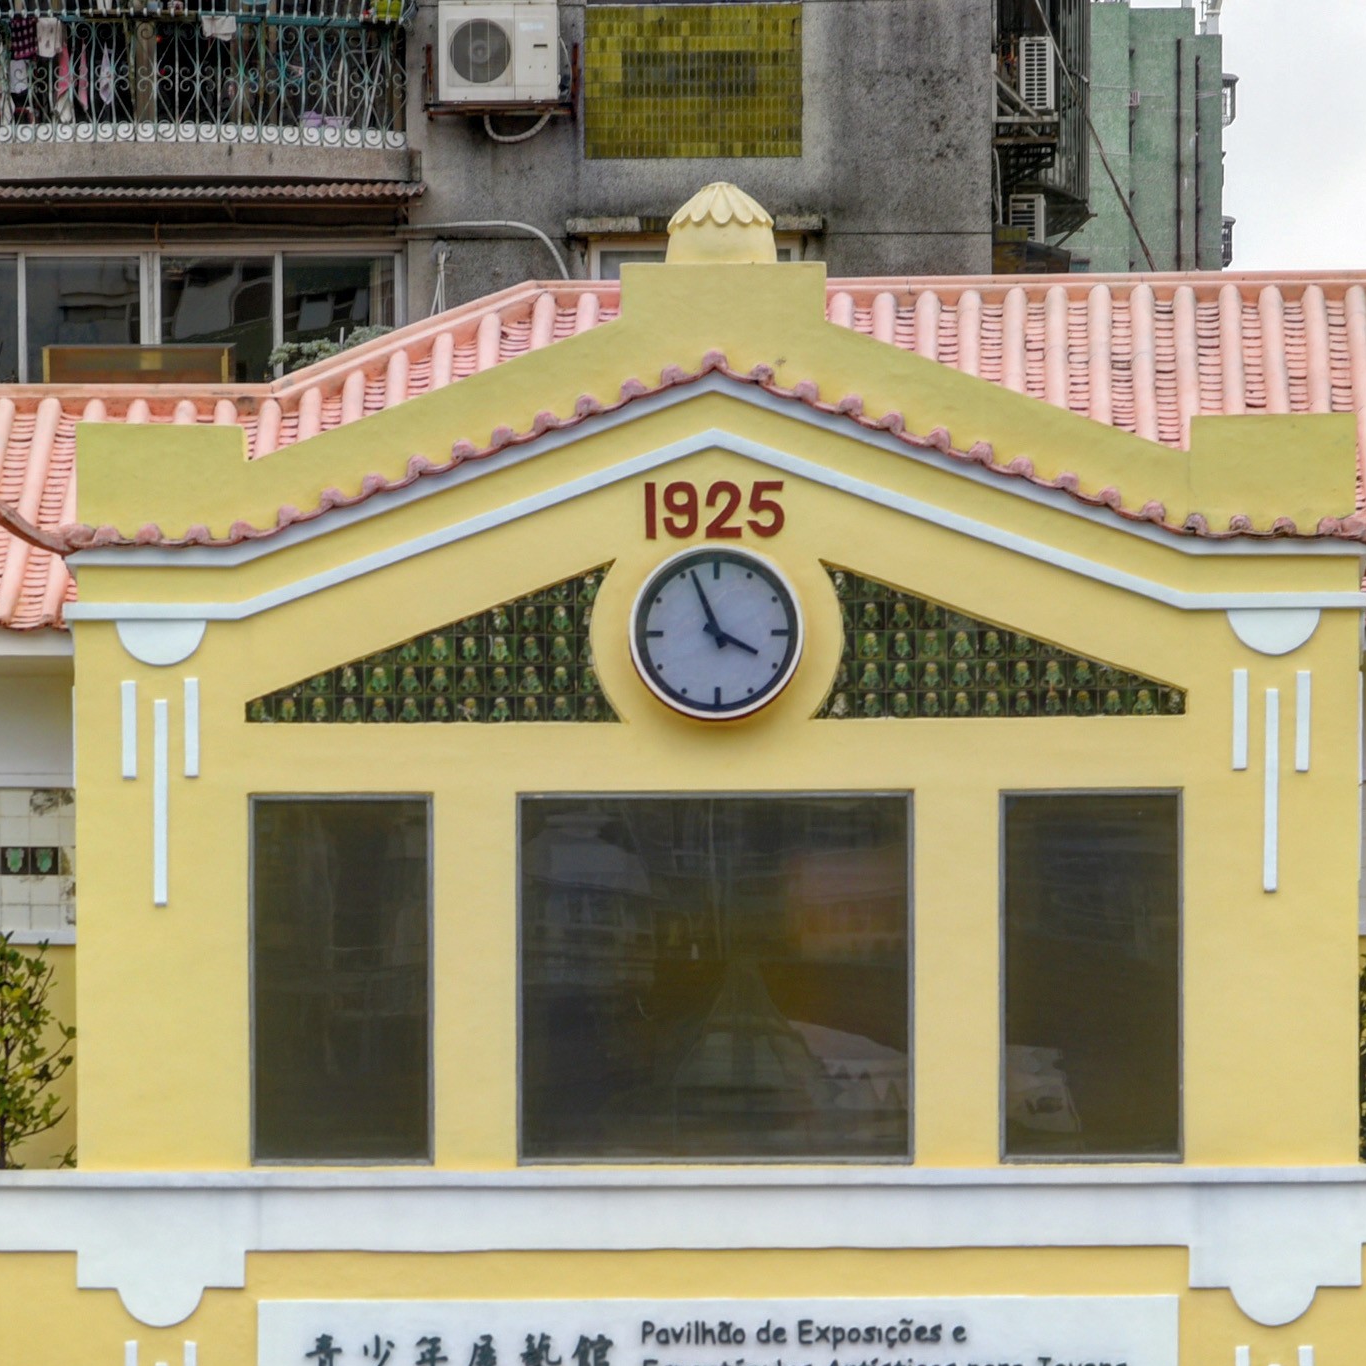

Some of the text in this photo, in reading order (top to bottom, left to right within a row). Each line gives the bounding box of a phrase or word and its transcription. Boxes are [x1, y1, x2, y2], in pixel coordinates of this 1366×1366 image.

[644, 480, 786, 540] 1925
[641, 1318, 967, 1351] Pavilhão de Exposições e
